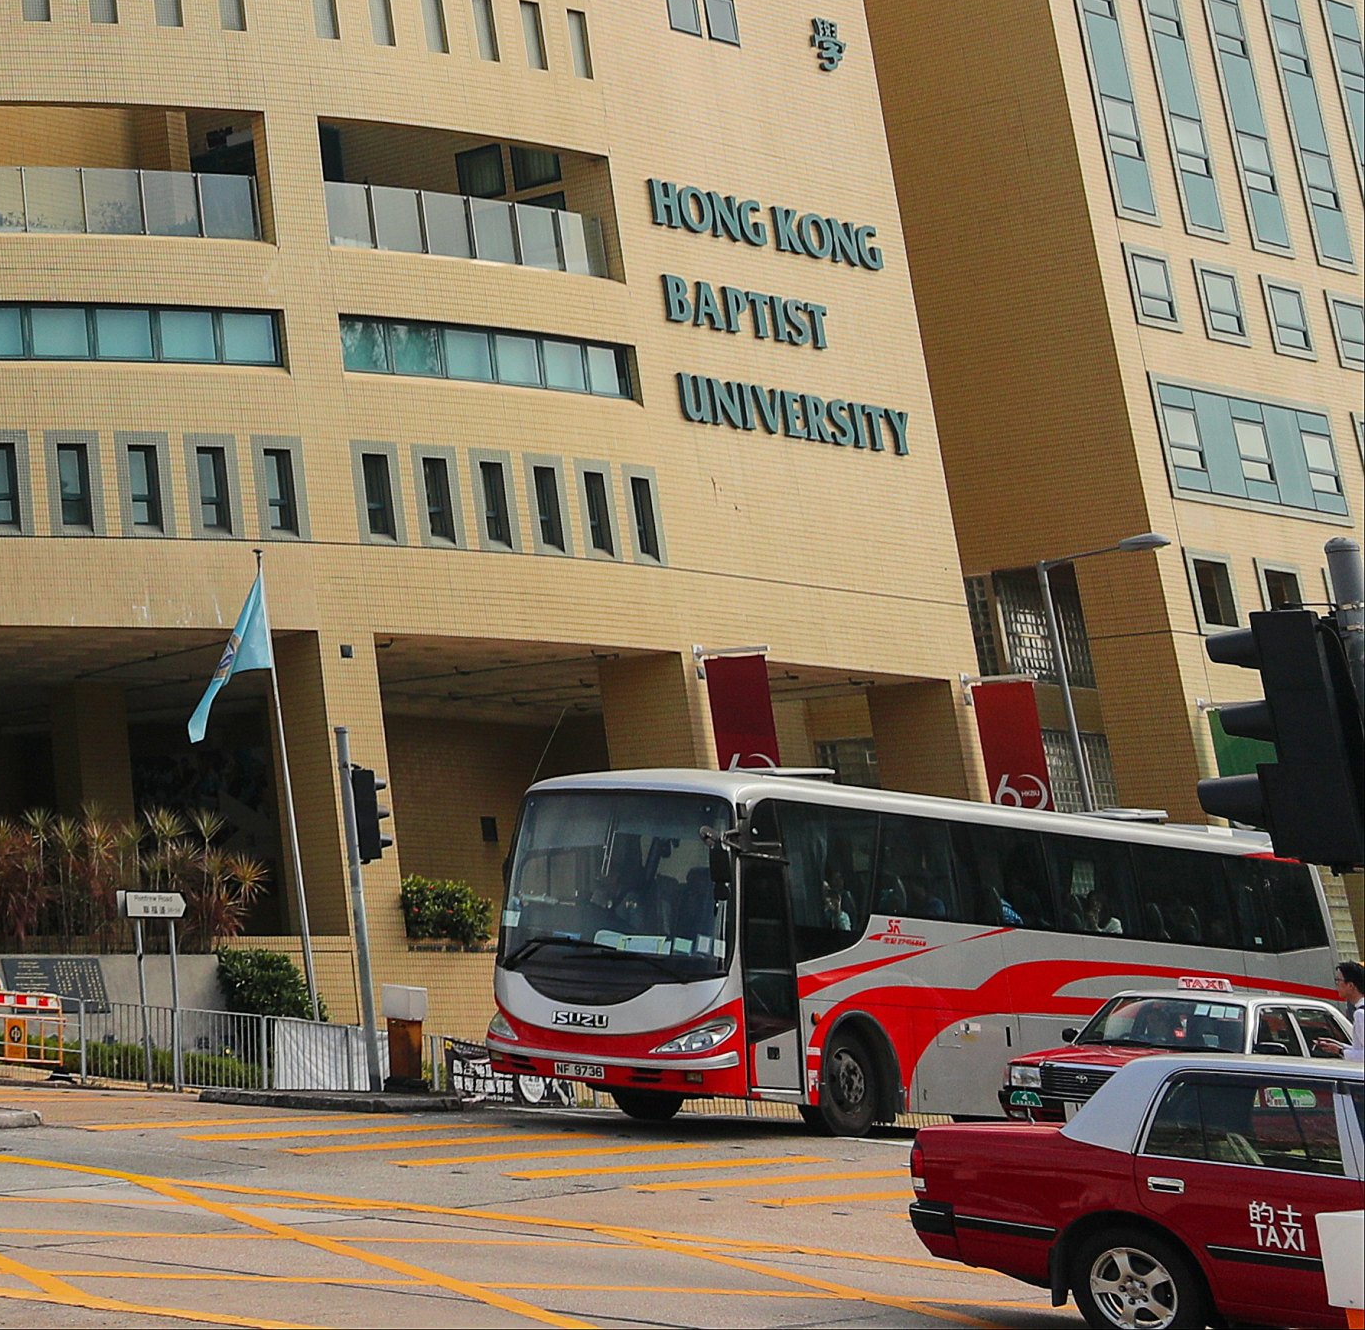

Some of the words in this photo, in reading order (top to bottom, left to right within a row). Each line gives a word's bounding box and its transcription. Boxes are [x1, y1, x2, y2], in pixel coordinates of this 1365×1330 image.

[645, 177, 768, 247] HONG
[769, 205, 885, 271] KONG
[660, 273, 828, 350] BAPTIST
[675, 371, 910, 456] UNIVERSITY
[1181, 978, 1225, 990] TAXI
[551, 1010, 609, 1029] ISUZU
[556, 1063, 569, 1074] NF
[1248, 1200, 1302, 1228] 的士
[1249, 1222, 1306, 1252] TAXI
